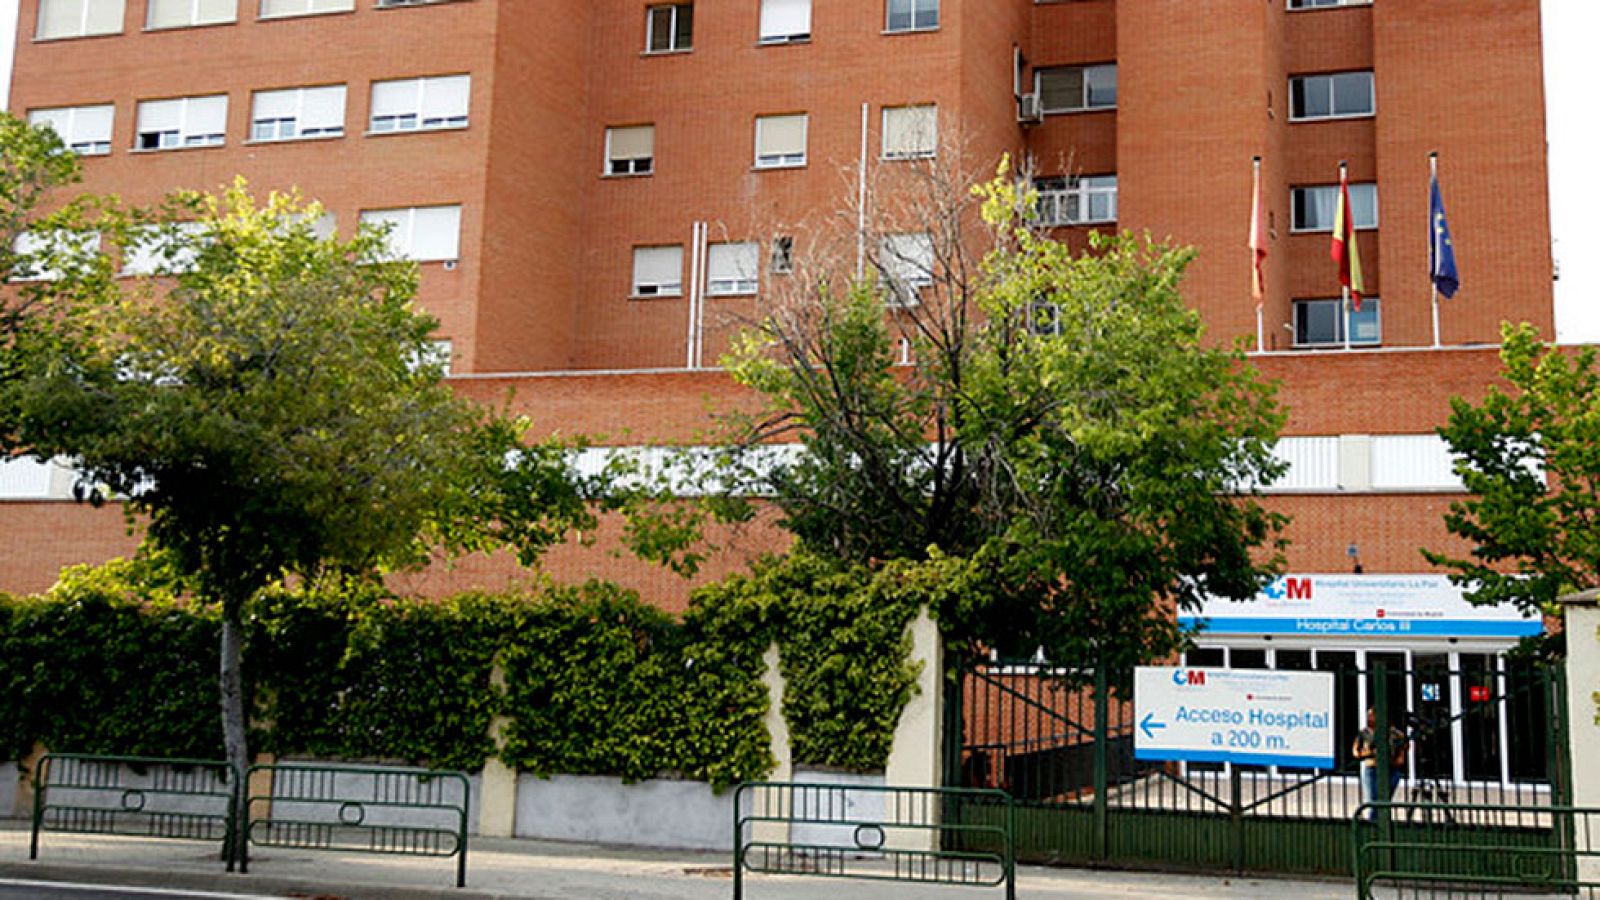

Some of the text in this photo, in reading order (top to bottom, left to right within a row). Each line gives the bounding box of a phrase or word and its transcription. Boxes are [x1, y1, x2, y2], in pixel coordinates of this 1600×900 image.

[1296, 618, 1350, 633] Hospital
[1353, 618, 1395, 631] Carlos
[1175, 705, 1328, 730] Acceso Hospital
[1211, 729, 1290, 749] a 200 m.
